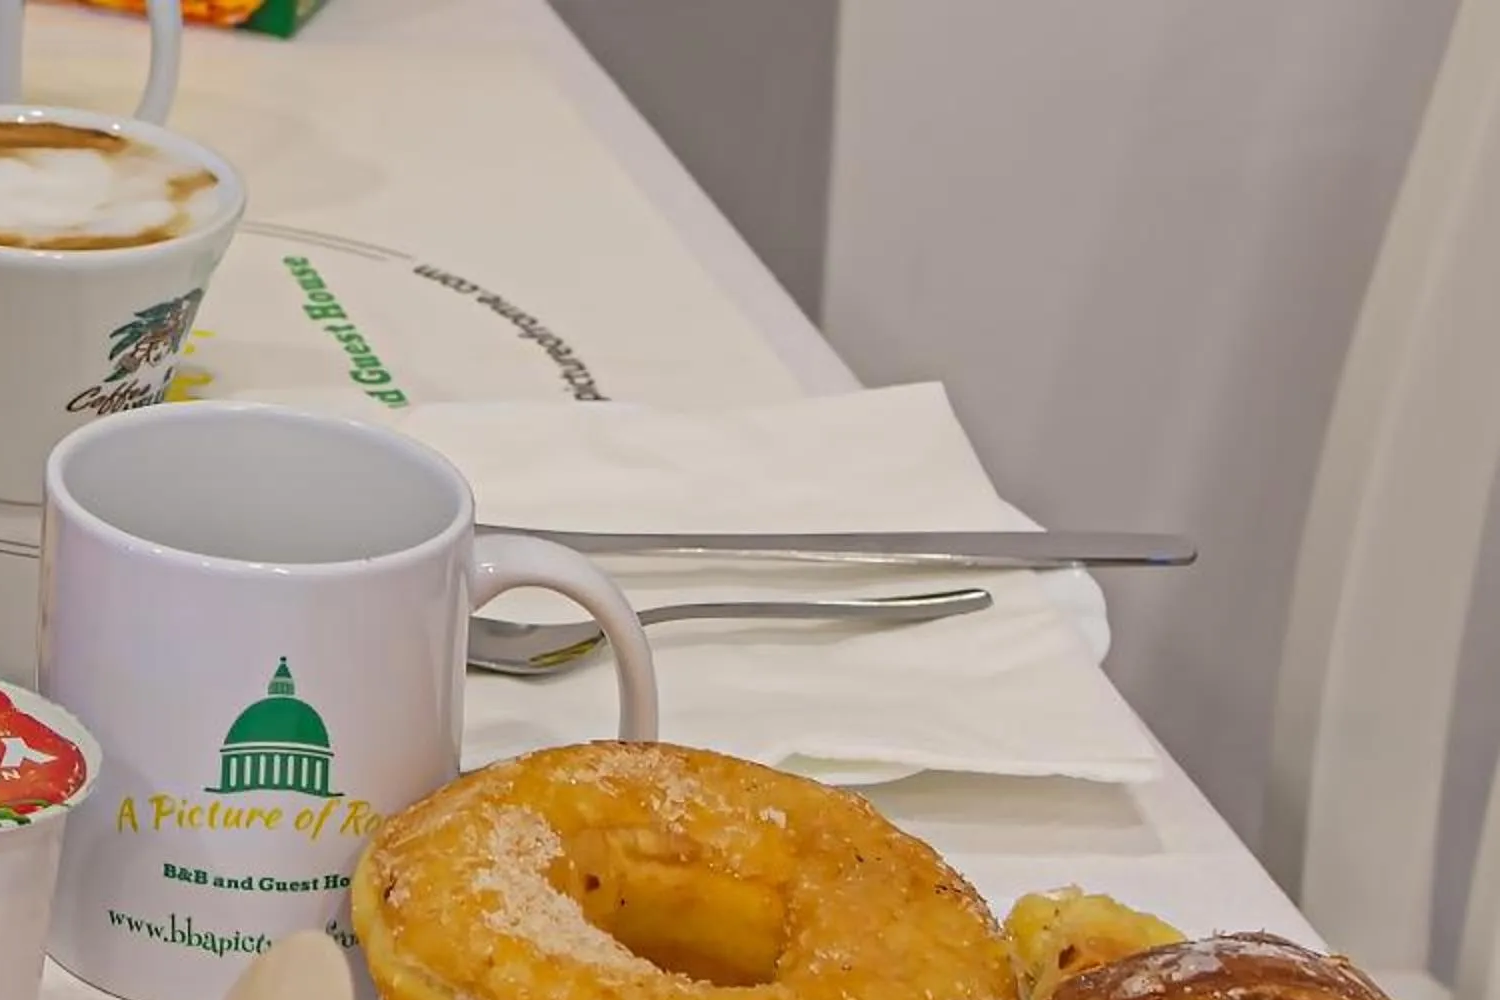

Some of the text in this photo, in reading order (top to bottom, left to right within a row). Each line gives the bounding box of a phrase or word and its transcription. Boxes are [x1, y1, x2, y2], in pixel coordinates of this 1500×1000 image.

[283, 256, 349, 321] House
[323, 324, 393, 386] Guest
[116, 793, 383, 840] A Picture of Ro
[163, 863, 209, 886] B&B
[213, 876, 253, 891] and
[258, 877, 319, 892] Guest
